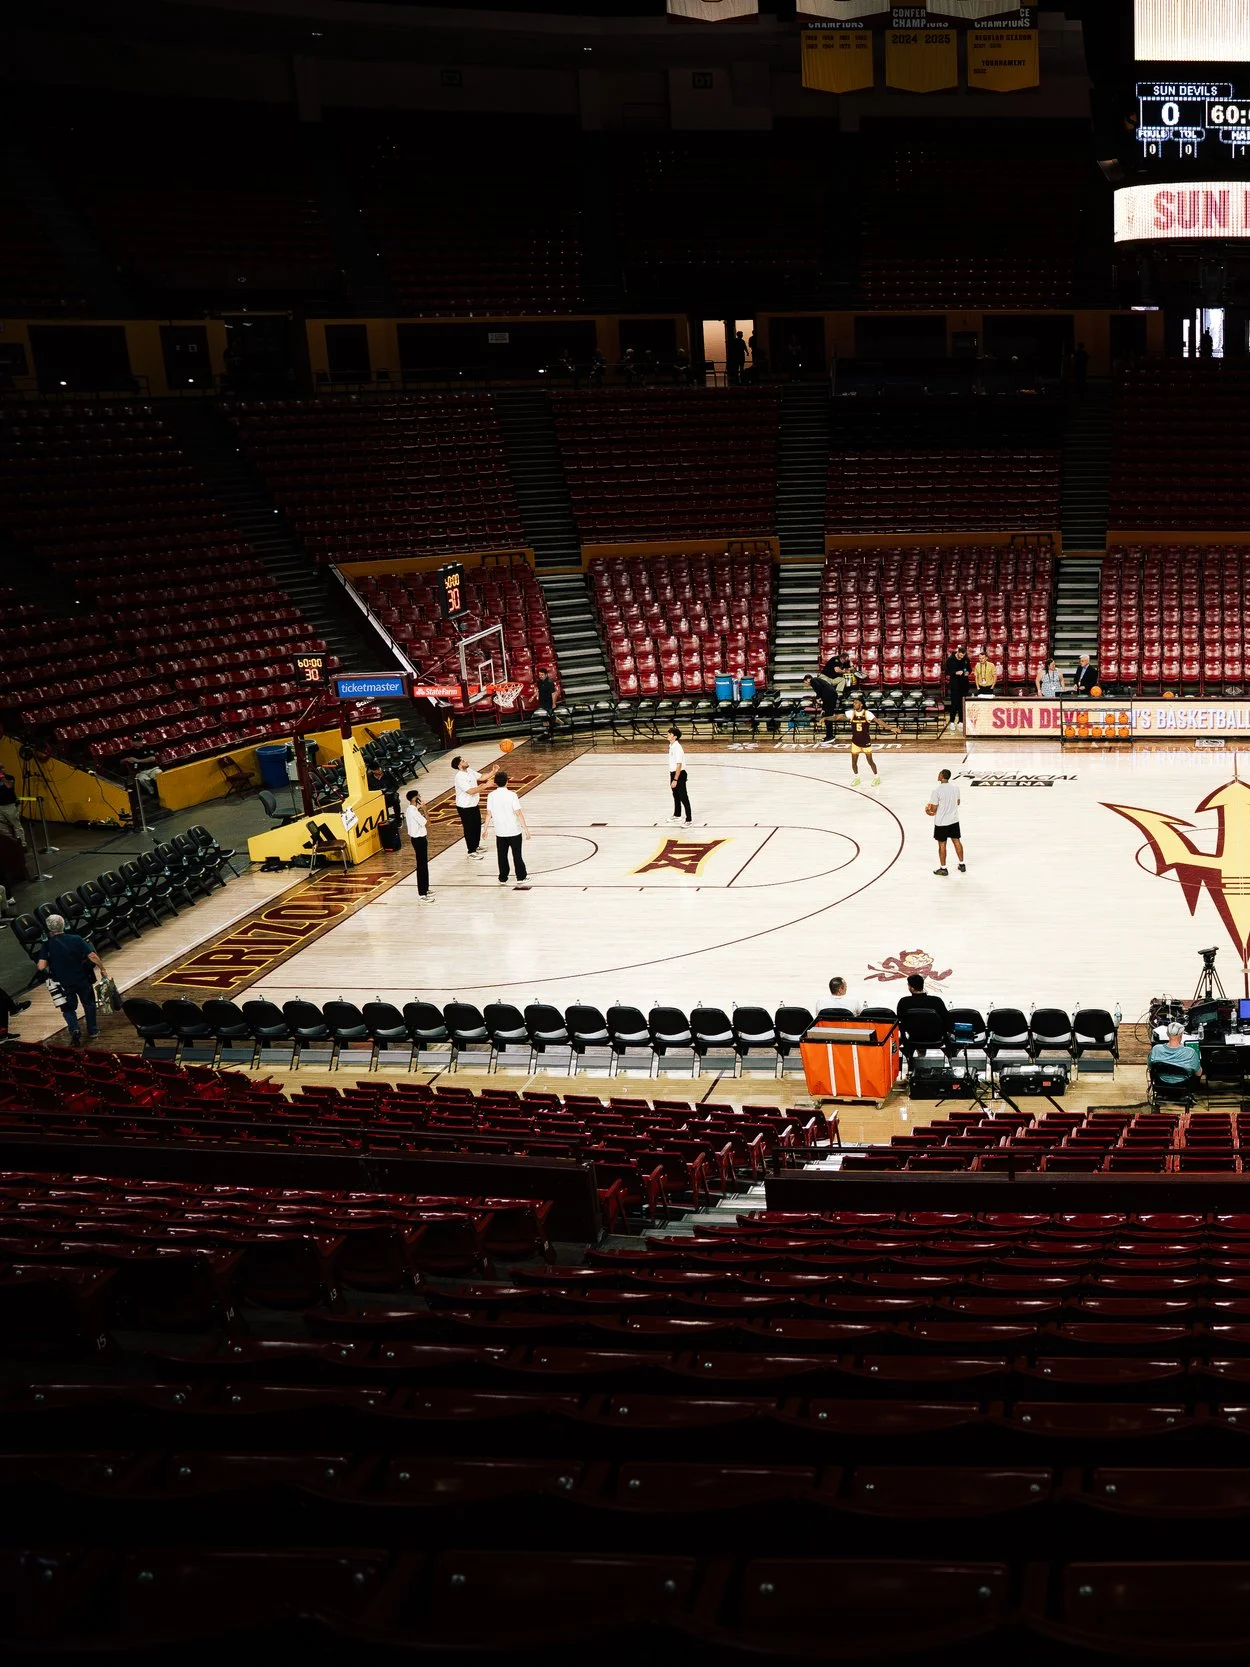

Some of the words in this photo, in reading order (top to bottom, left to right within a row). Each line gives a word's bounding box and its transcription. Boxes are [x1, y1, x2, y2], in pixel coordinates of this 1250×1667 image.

[892, 8, 926, 18] CONFER
[892, 34, 918, 44] 2024
[925, 34, 950, 44] 2025
[1154, 86, 1175, 96] SUN
[1180, 86, 1218, 96] DEVILS
[1161, 102, 1180, 125] 0
[1138, 130, 1167, 138] FOULS
[1180, 130, 1196, 138] TOL
[1149, 144, 1156, 154] 0
[1185, 144, 1192, 154] 0
[1241, 146, 1246, 156] 1
[1154, 190, 1230, 230] SUN
[448, 588, 460, 612] 30
[305, 669, 318, 681] 30
[341, 682, 399, 692] ticketmaster
[992, 707, 1034, 729] SUN
[772, 742, 902, 750] invisagn
[152, 871, 401, 990] ARIZONA
[96, 1333, 107, 1350] 15
